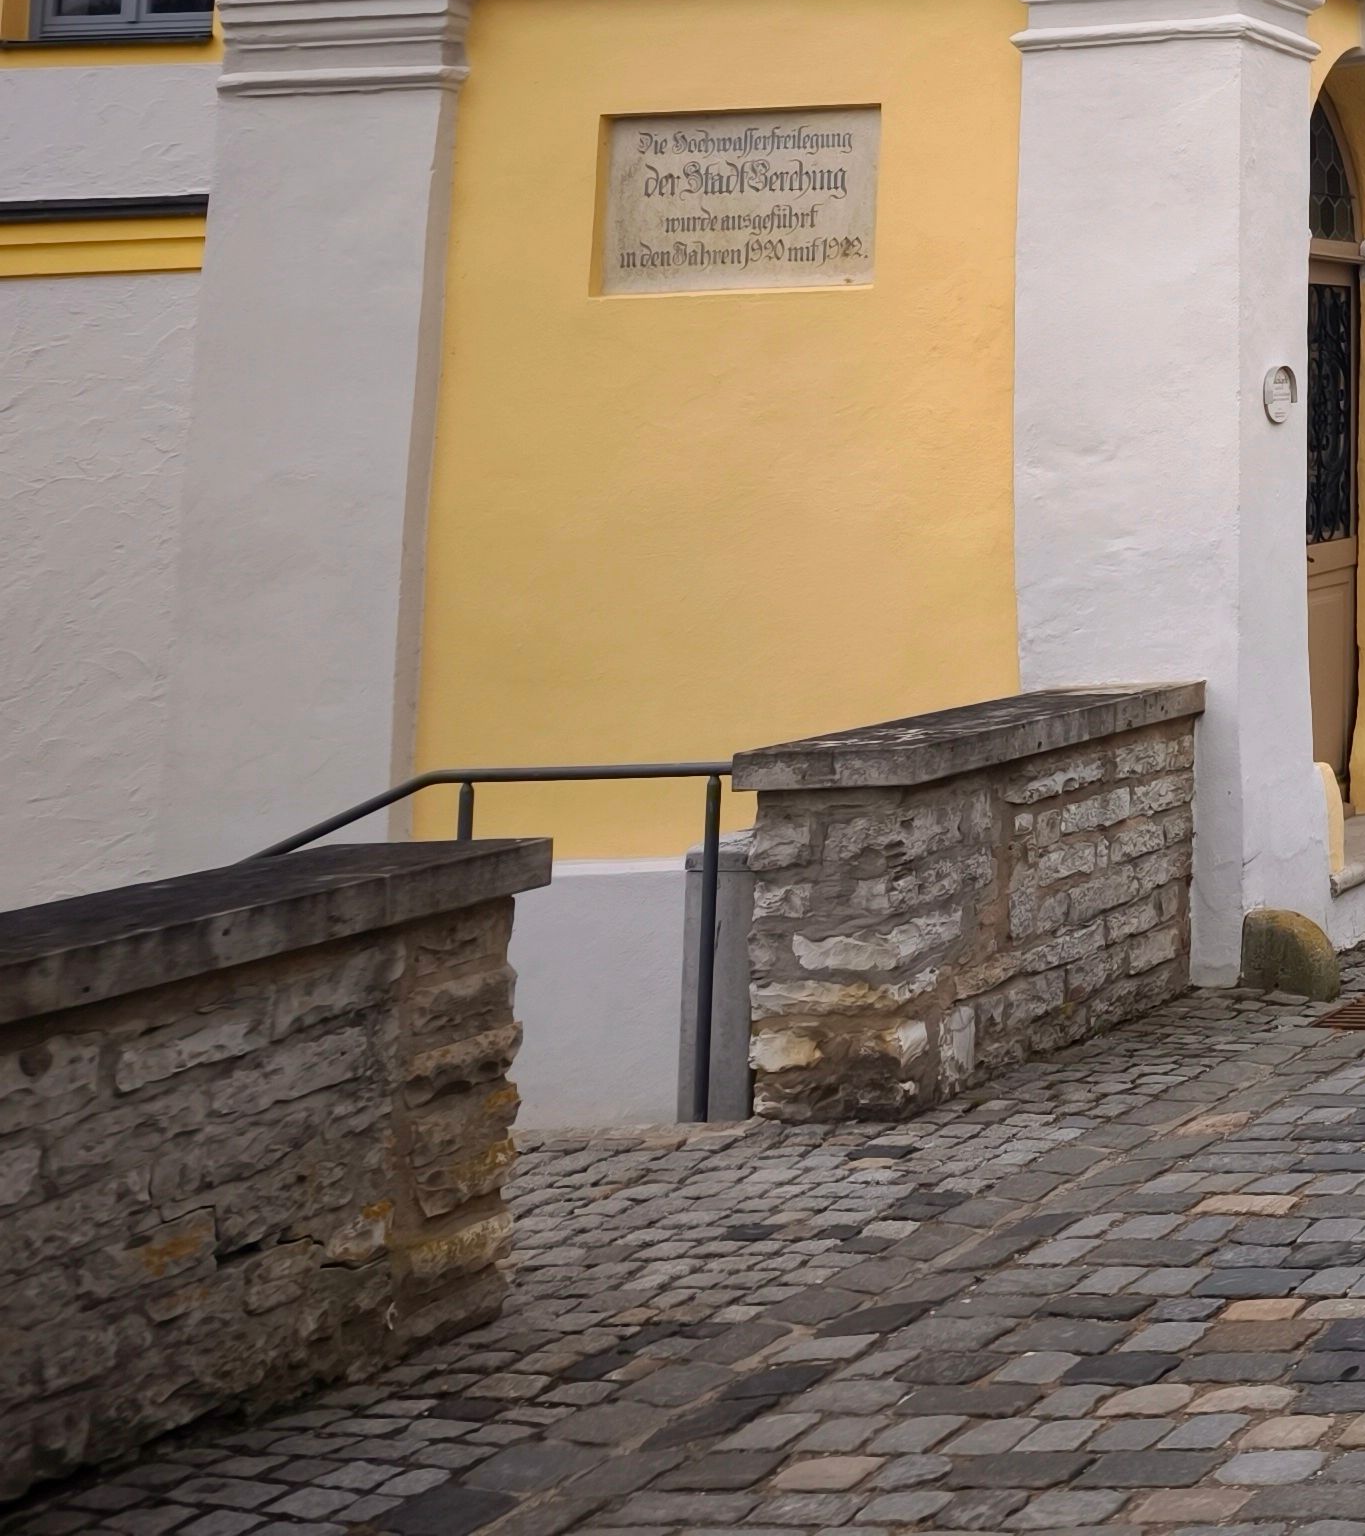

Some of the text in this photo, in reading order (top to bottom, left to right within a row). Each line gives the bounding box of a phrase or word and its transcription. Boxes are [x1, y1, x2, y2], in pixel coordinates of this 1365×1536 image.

[637, 131, 668, 155] Die
[644, 159, 848, 201] der Stadt Berching
[665, 204, 825, 236] wurde ausgeführt
[619, 250, 637, 269] in
[640, 240, 671, 268] den
[672, 240, 741, 272] Jahren
[740, 238, 785, 271] 1920
[787, 237, 822, 262] mit
